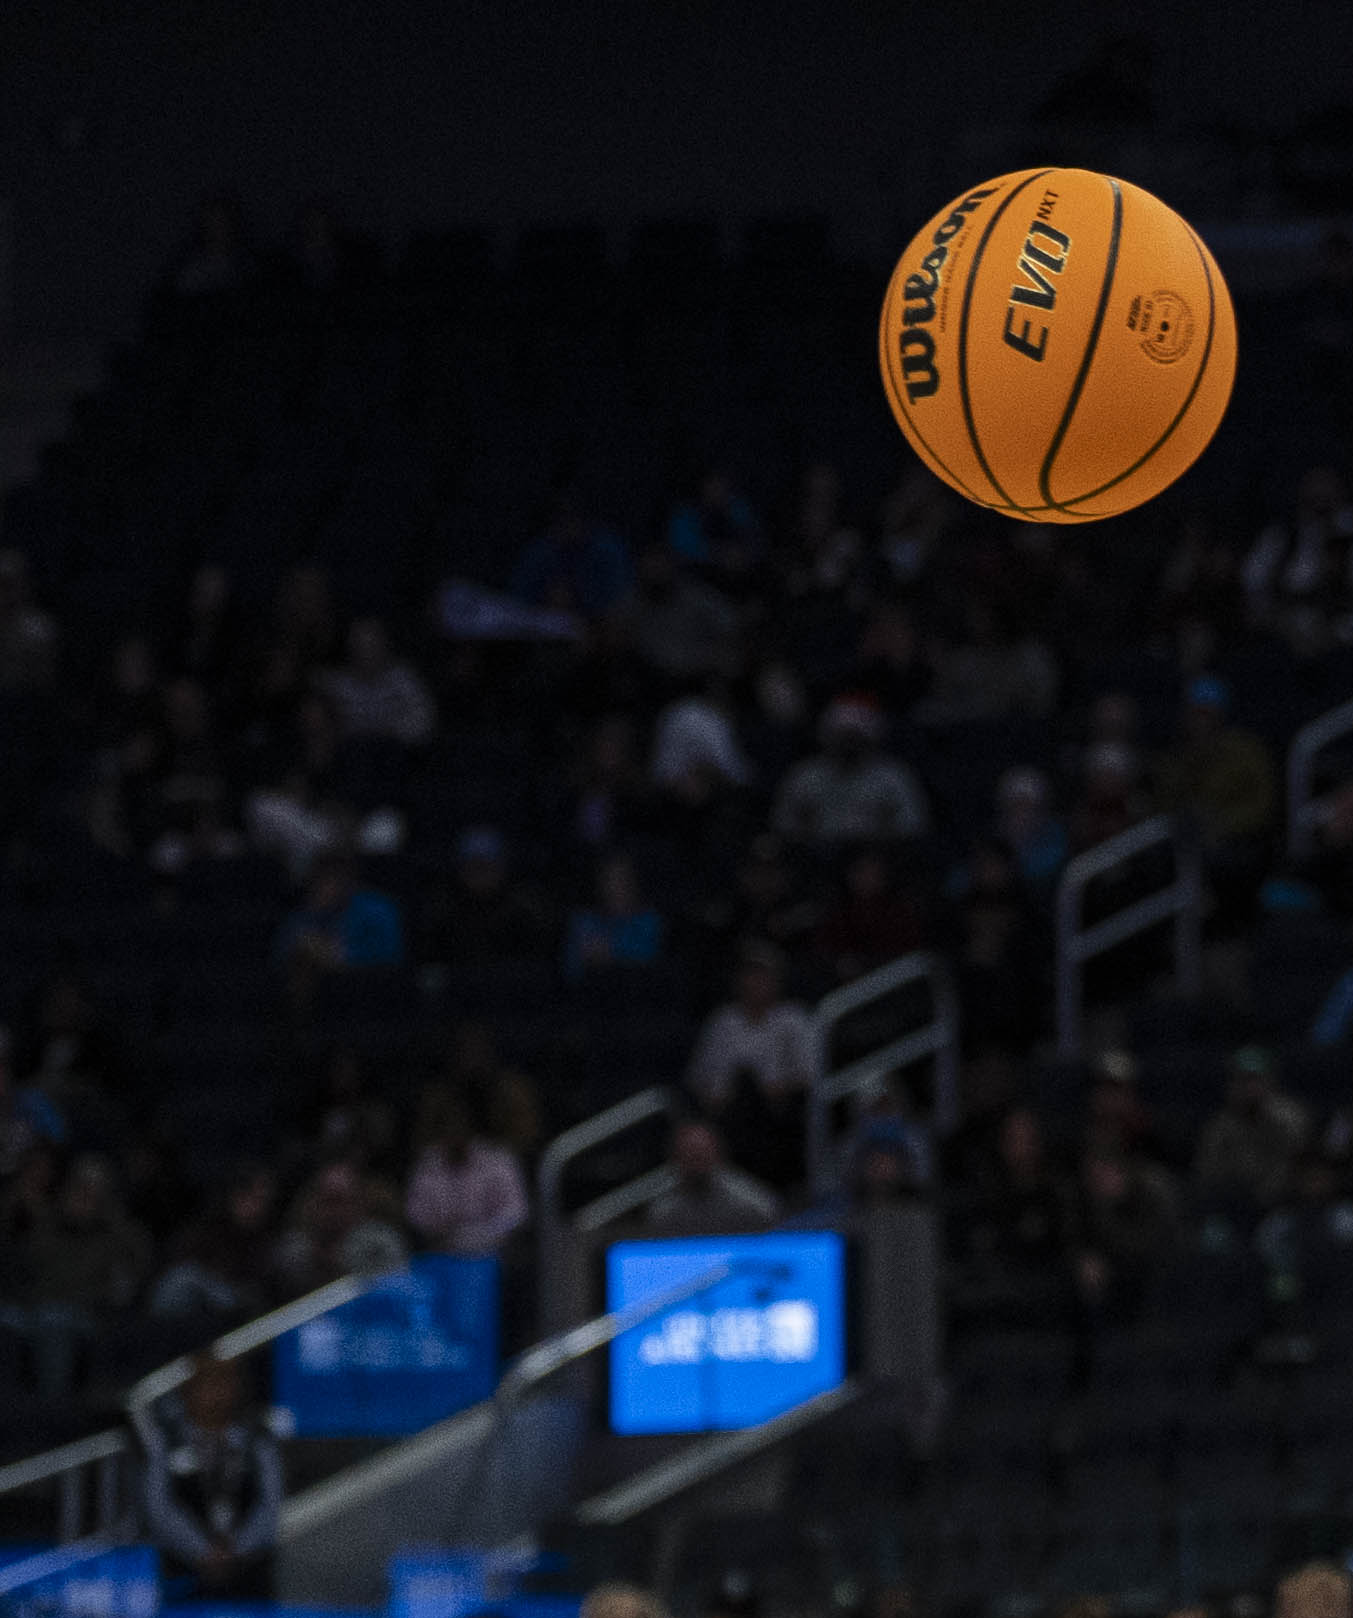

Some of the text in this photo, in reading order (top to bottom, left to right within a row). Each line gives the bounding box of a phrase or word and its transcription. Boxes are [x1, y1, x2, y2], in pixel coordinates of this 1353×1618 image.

[900, 183, 1002, 405] Wilson
[1003, 190, 1073, 363] EVO NXT
